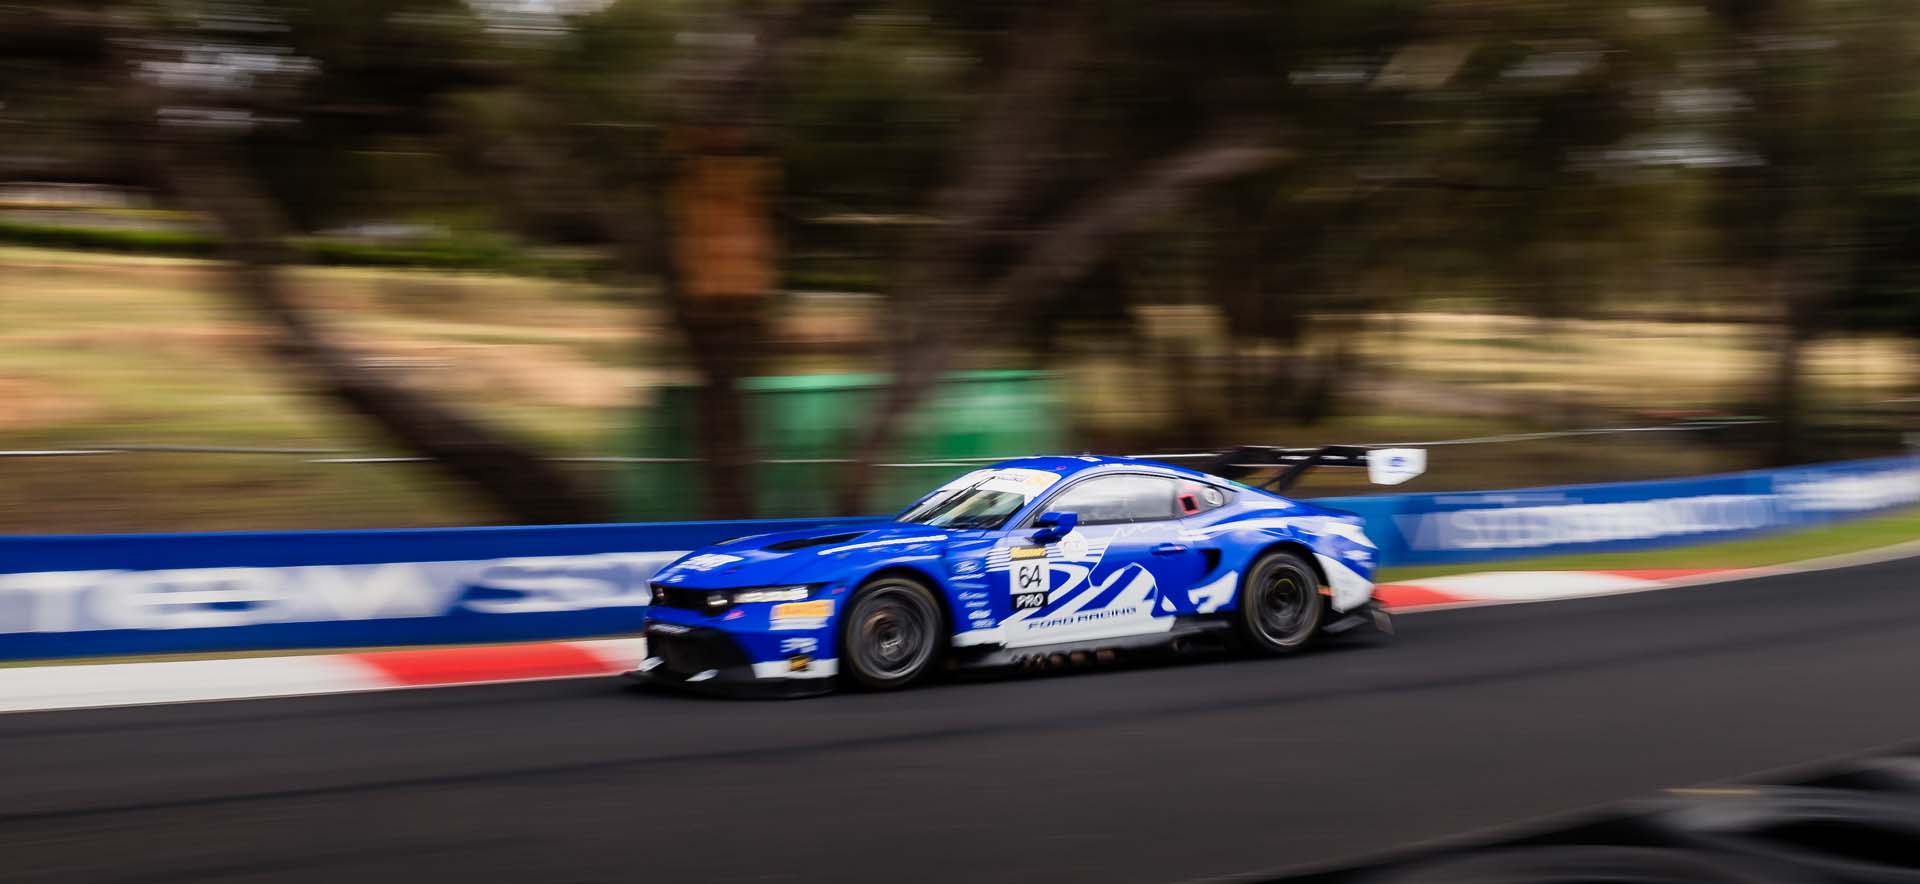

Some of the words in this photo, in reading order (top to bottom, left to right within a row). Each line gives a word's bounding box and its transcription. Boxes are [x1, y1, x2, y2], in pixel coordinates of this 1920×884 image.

[1019, 564, 1042, 589] 64
[1016, 592, 1045, 609] PRO
[1028, 617, 1074, 630] FORD
[1077, 607, 1137, 623] RACING
